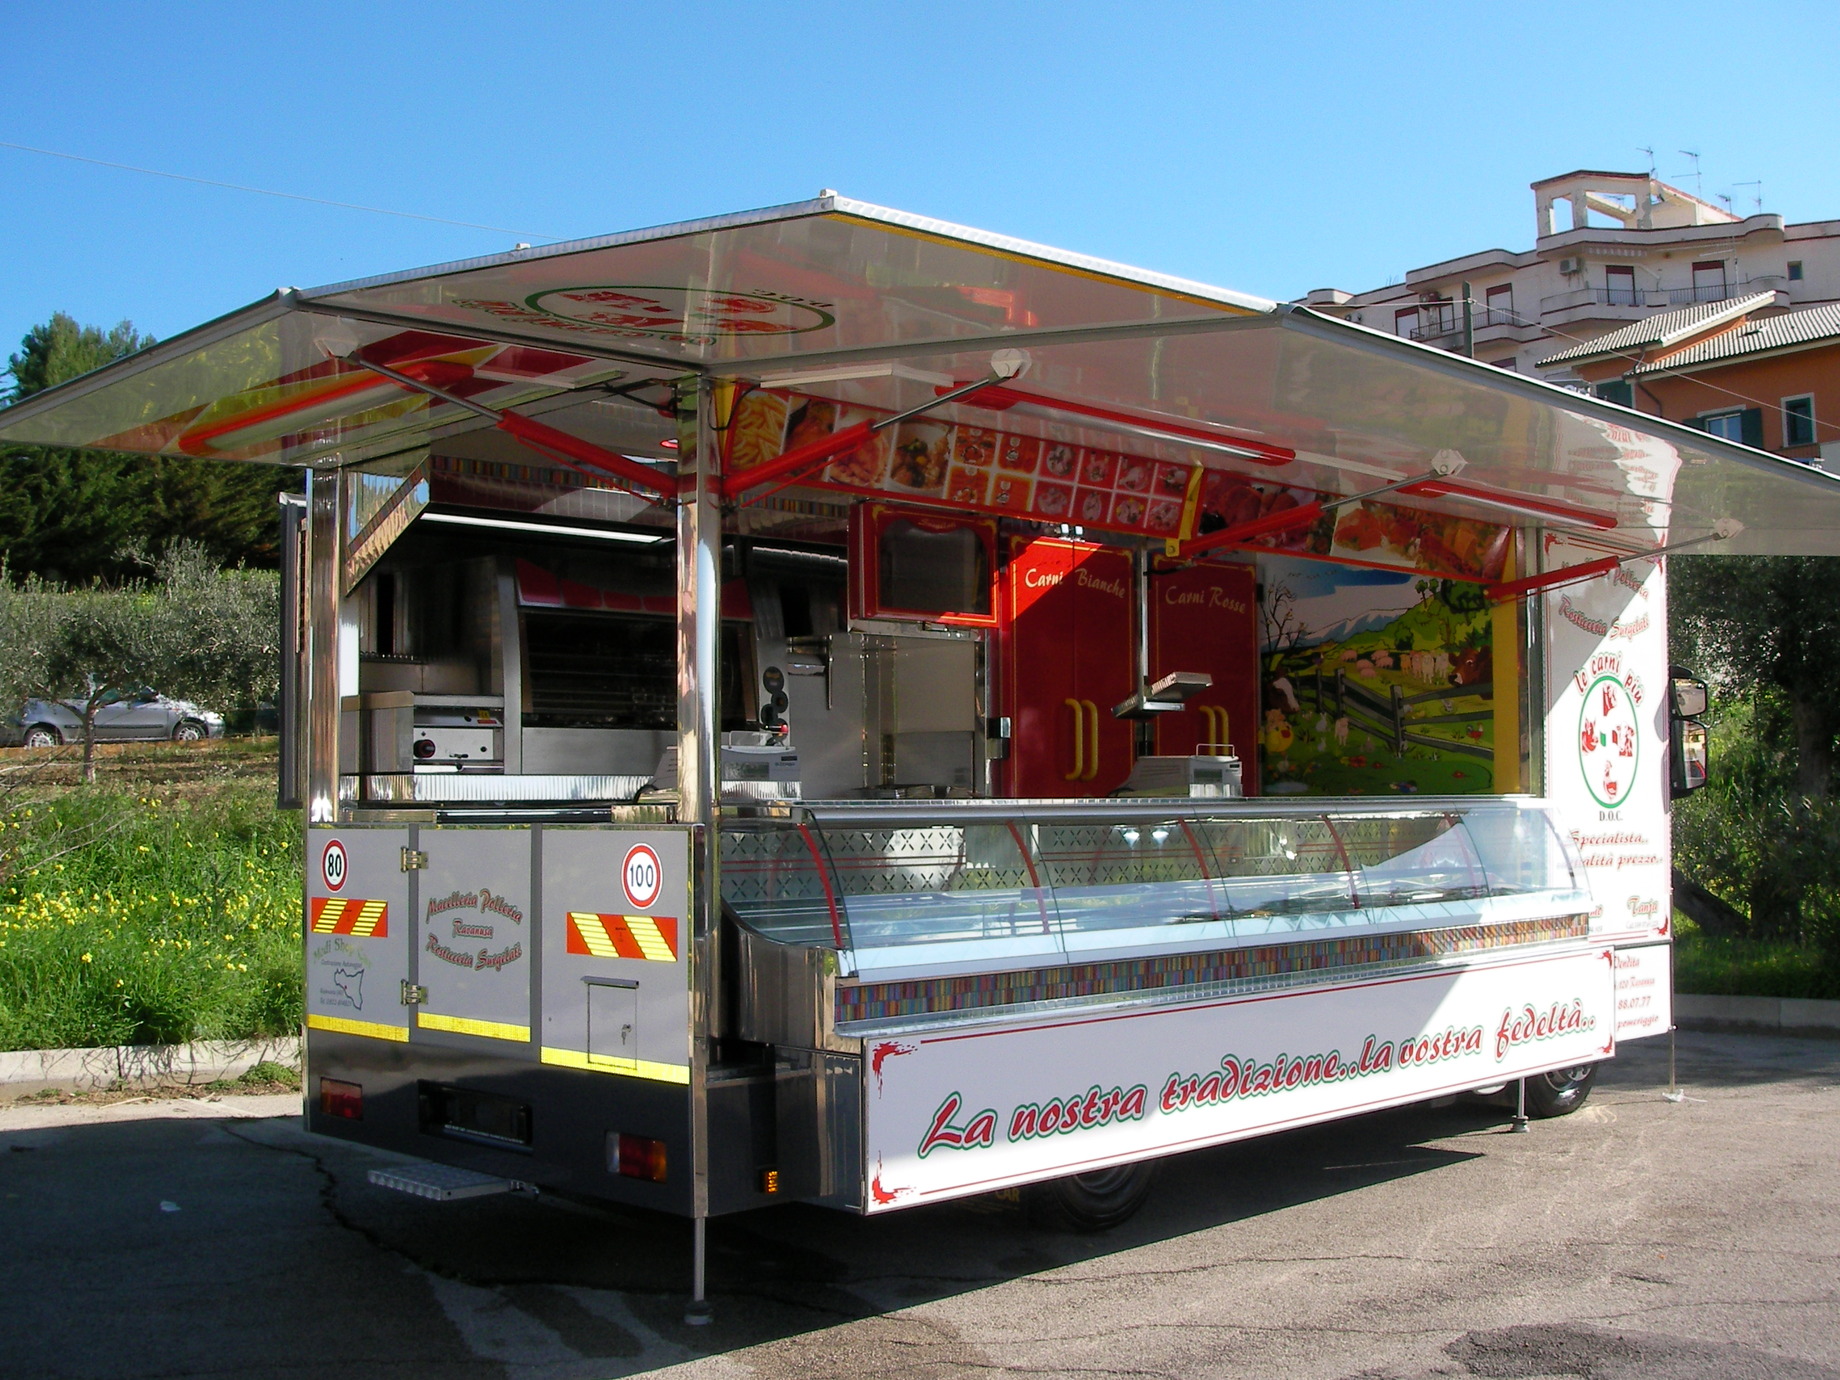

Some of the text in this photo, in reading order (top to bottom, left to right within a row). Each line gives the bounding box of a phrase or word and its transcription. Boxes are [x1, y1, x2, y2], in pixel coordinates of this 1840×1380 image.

[1024, 567, 1126, 599] Carni Bianche
[1165, 585, 1246, 614] Carni Rosse
[1573, 669, 1589, 696] le
[1589, 650, 1624, 678] carni
[1599, 810, 1624, 821] D.O.C.
[327, 852, 342, 877] 80
[629, 862, 655, 888] 100
[426, 888, 524, 925] Macelleria Polleria
[452, 918, 494, 939] Ravanusa
[426, 932, 523, 972] Rosticceria Surgelati
[918, 1090, 998, 1159] La
[1007, 1084, 1148, 1143] nostra
[1397, 1025, 1485, 1070] vostra
[1495, 998, 1598, 1063] fedeltà..
